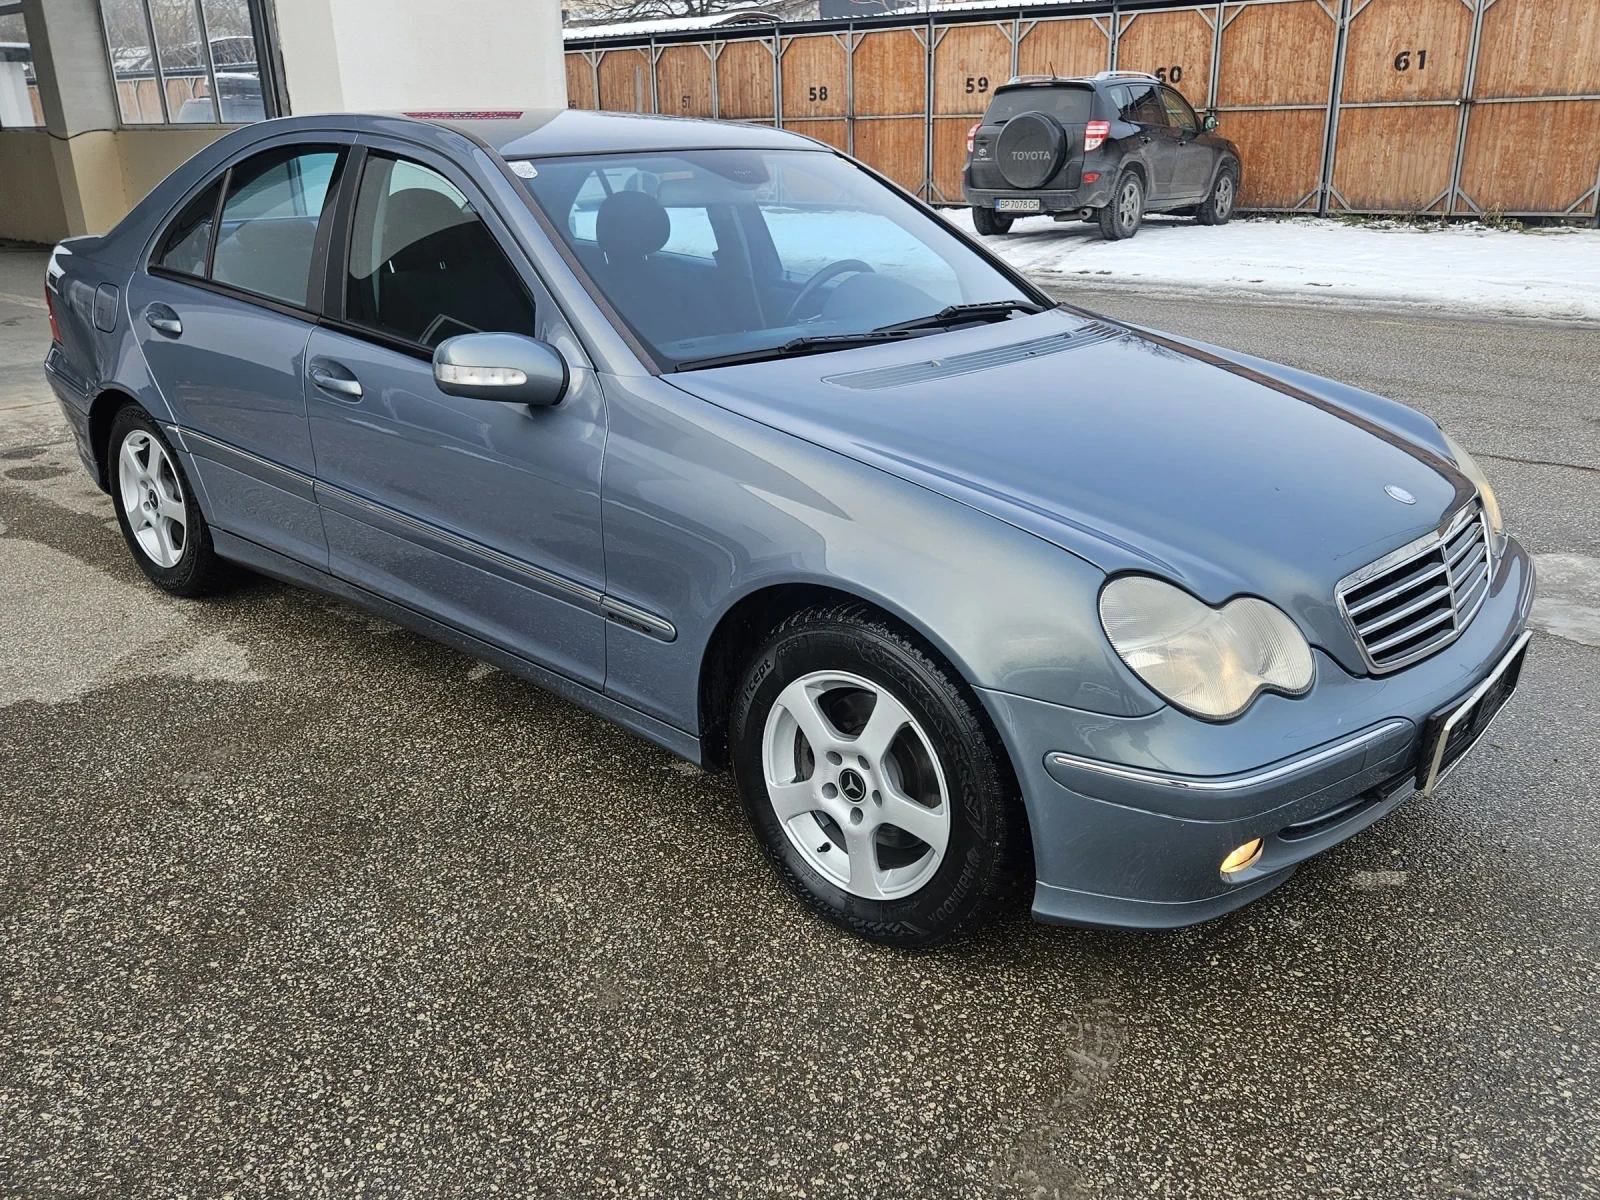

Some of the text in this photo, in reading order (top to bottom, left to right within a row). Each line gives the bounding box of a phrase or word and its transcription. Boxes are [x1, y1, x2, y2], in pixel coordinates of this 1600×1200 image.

[1394, 50, 1427, 71] 61
[1155, 66, 1182, 84] 60
[965, 76, 989, 94] 59
[682, 96, 691, 108] 57
[809, 86, 828, 102] 58
[1012, 151, 1051, 160] TOYOTA
[1010, 200, 1028, 209] 7078
[1028, 200, 1039, 209] CH
